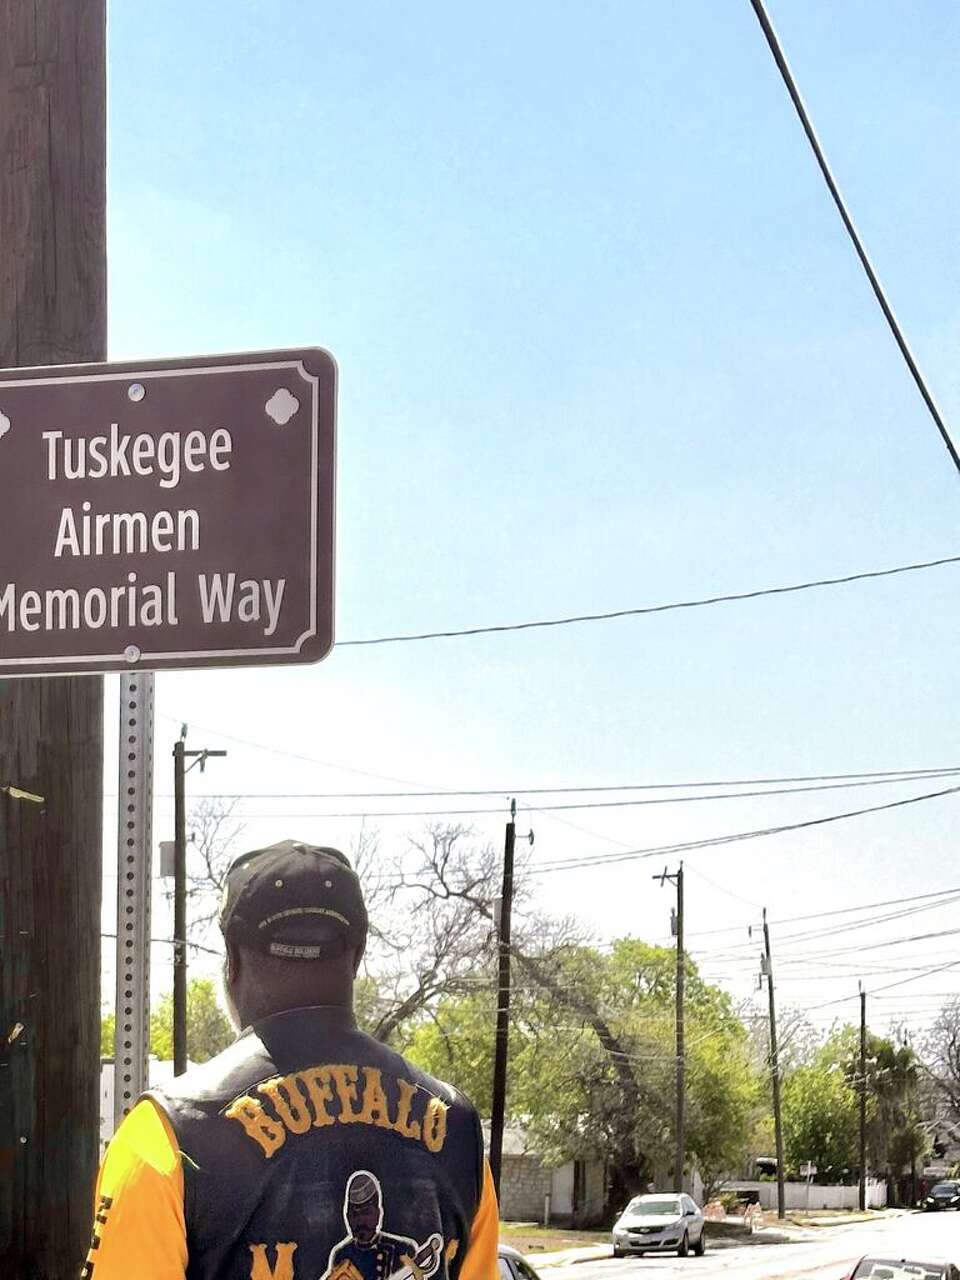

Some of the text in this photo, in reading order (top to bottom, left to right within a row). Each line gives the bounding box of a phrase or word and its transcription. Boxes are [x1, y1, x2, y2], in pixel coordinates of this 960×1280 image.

[42, 423, 233, 489] Tuskegee
[53, 501, 200, 557] Airmen
[198, 573, 286, 636] Way
[224, 1063, 449, 1159] BUFFALO
